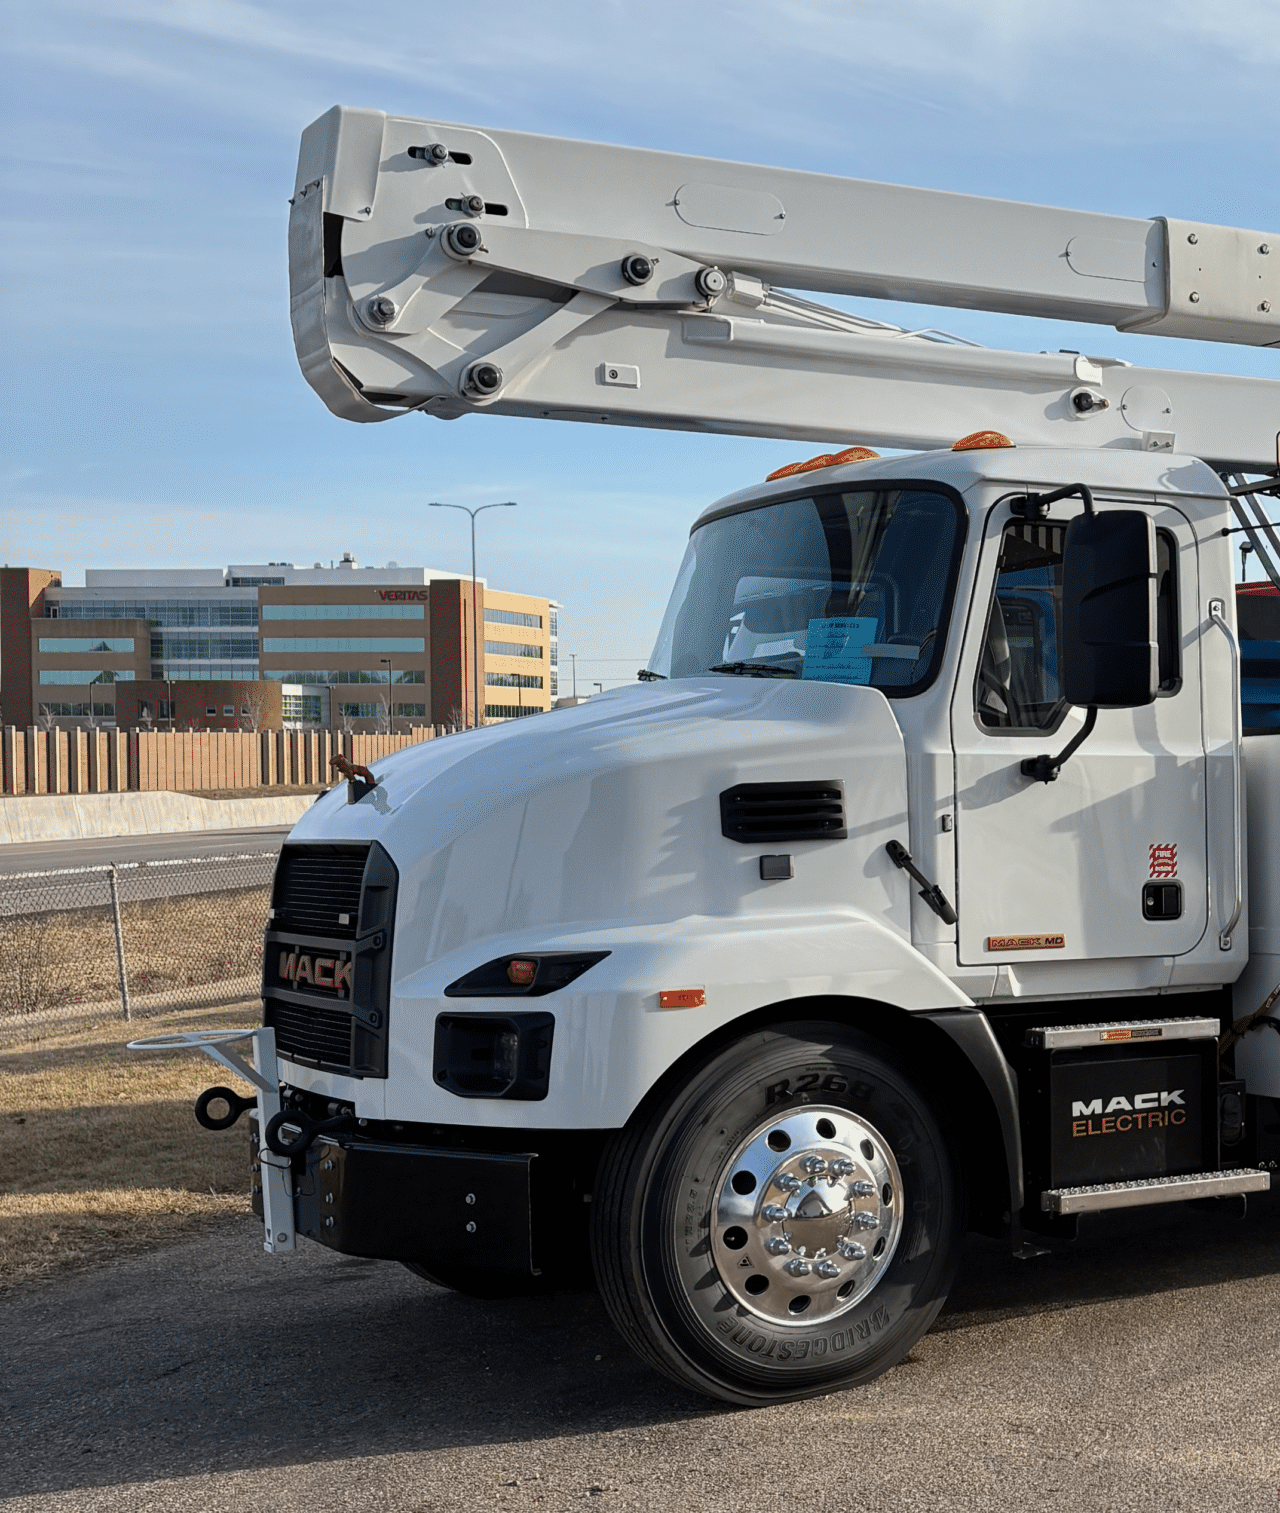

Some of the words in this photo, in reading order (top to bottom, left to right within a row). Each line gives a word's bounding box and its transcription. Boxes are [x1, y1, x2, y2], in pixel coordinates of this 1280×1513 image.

[379, 590, 427, 601] VERITAS
[1155, 850, 1172, 858] FIRE
[991, 938, 1041, 948] MACK
[1044, 936, 1064, 945] MD
[279, 951, 352, 990] MACK
[764, 1073, 876, 1106] R268
[1072, 1089, 1186, 1117] MACK
[1072, 1109, 1186, 1138] ELECTRIC
[715, 1303, 891, 1362] BRIDGESTONE
